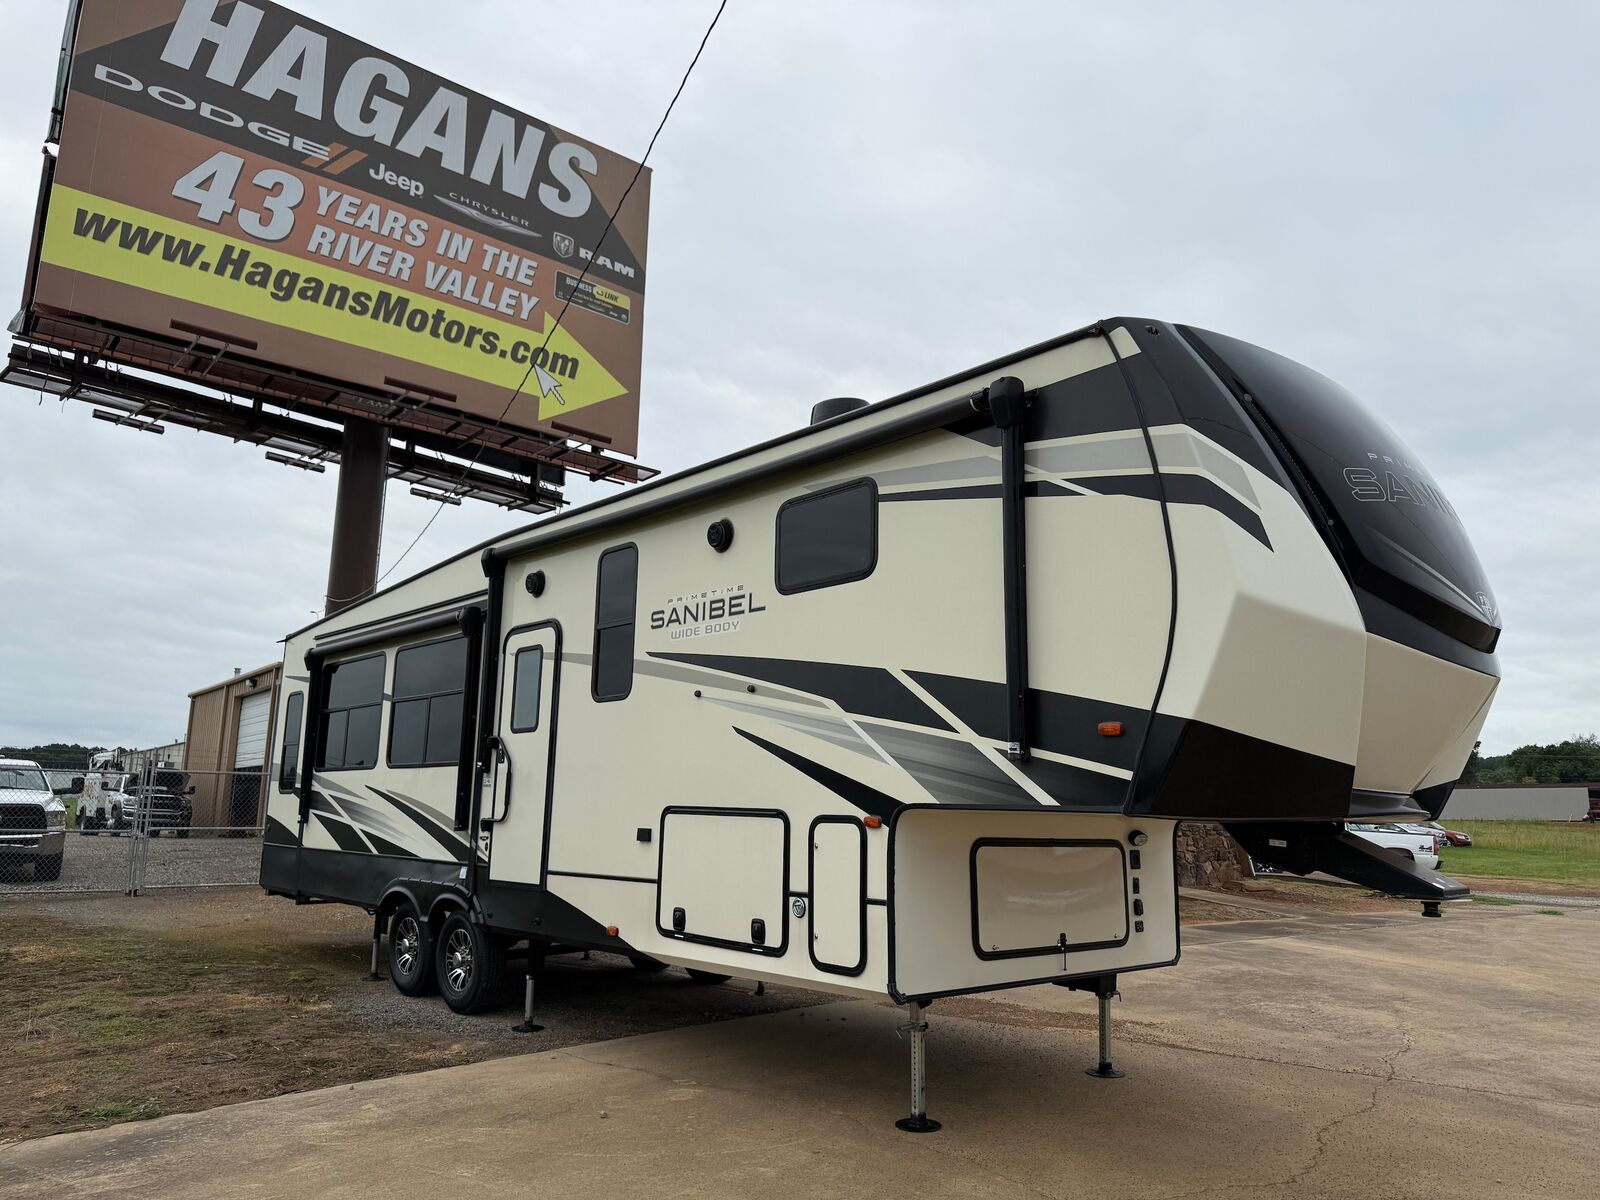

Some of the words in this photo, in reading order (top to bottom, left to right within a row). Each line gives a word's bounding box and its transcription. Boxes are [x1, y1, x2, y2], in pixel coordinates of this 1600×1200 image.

[94, 63, 331, 162] DODGE
[160, 0, 598, 218] HAGANS
[170, 150, 305, 241] 43
[369, 162, 425, 198] Jeep
[448, 191, 530, 227] CHRYSLER
[317, 185, 429, 248] YEARS
[436, 229, 474, 265] IN
[482, 244, 539, 287] THE
[307, 223, 416, 282] RIVER
[424, 260, 540, 321] VALLEY
[578, 246, 635, 279] RAM
[73, 207, 580, 380] www.HagansMotors.com
[603, 288, 620, 303] LINK
[650, 592, 766, 630] SANIBEL
[667, 584, 744, 604] PRIMETIME
[670, 626, 701, 640] WIDE
[704, 620, 740, 635] BODY
